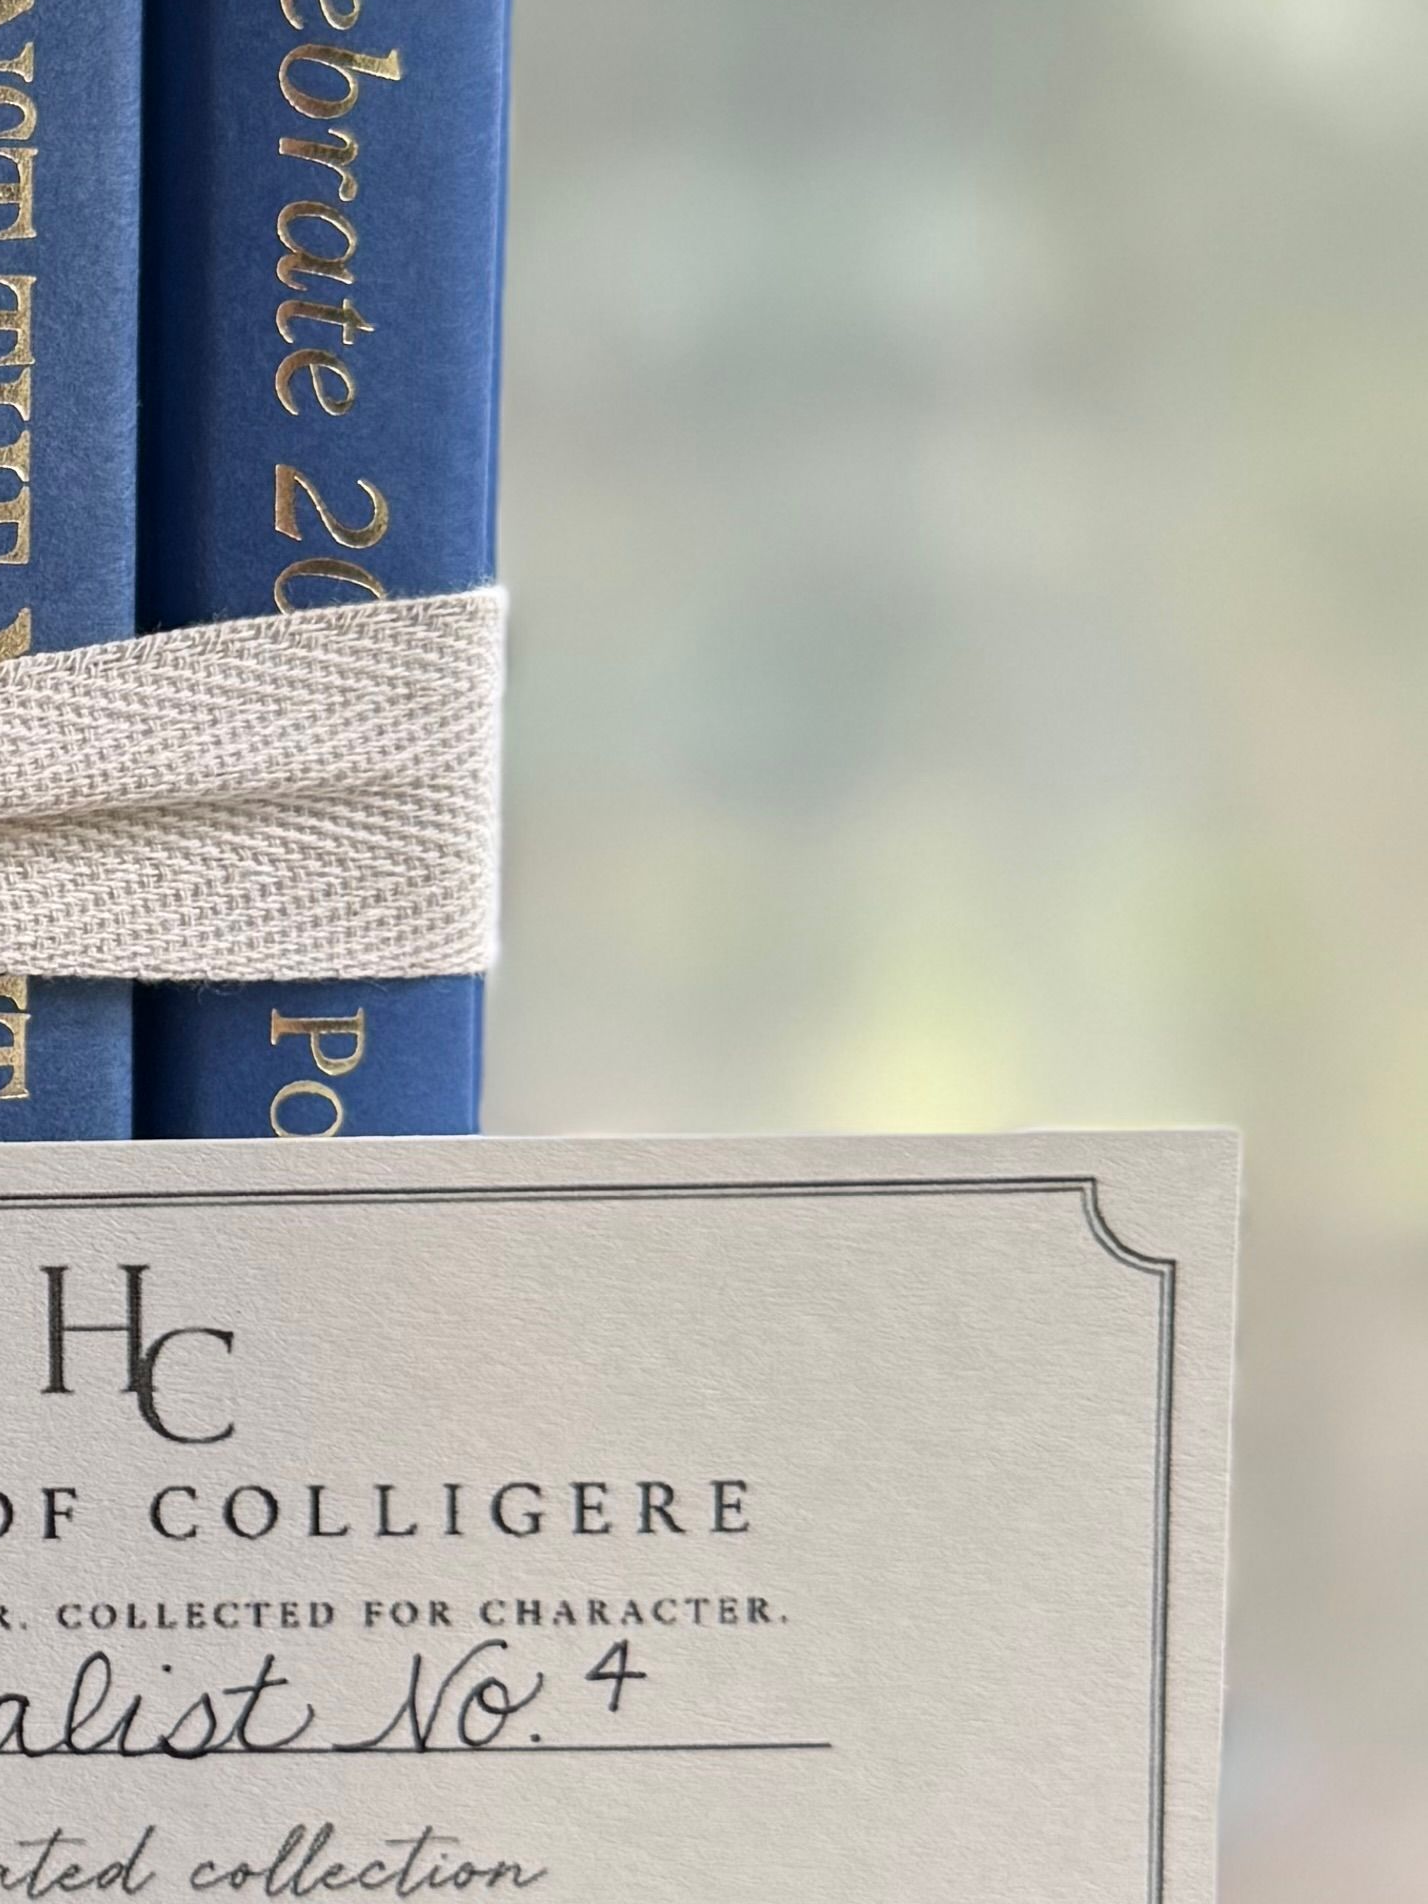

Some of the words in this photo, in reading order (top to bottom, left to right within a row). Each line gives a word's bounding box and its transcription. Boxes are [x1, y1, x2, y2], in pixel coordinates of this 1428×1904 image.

[148, 1479, 751, 1542] COLLIGERE
[56, 1600, 337, 1631] COLLECTED
[362, 1599, 452, 1628] FOR
[477, 1595, 790, 1627] CHARACTER.
[332, 1638, 544, 1754] No.
[584, 1638, 648, 1714] 4
[188, 1821, 549, 1900] collection
